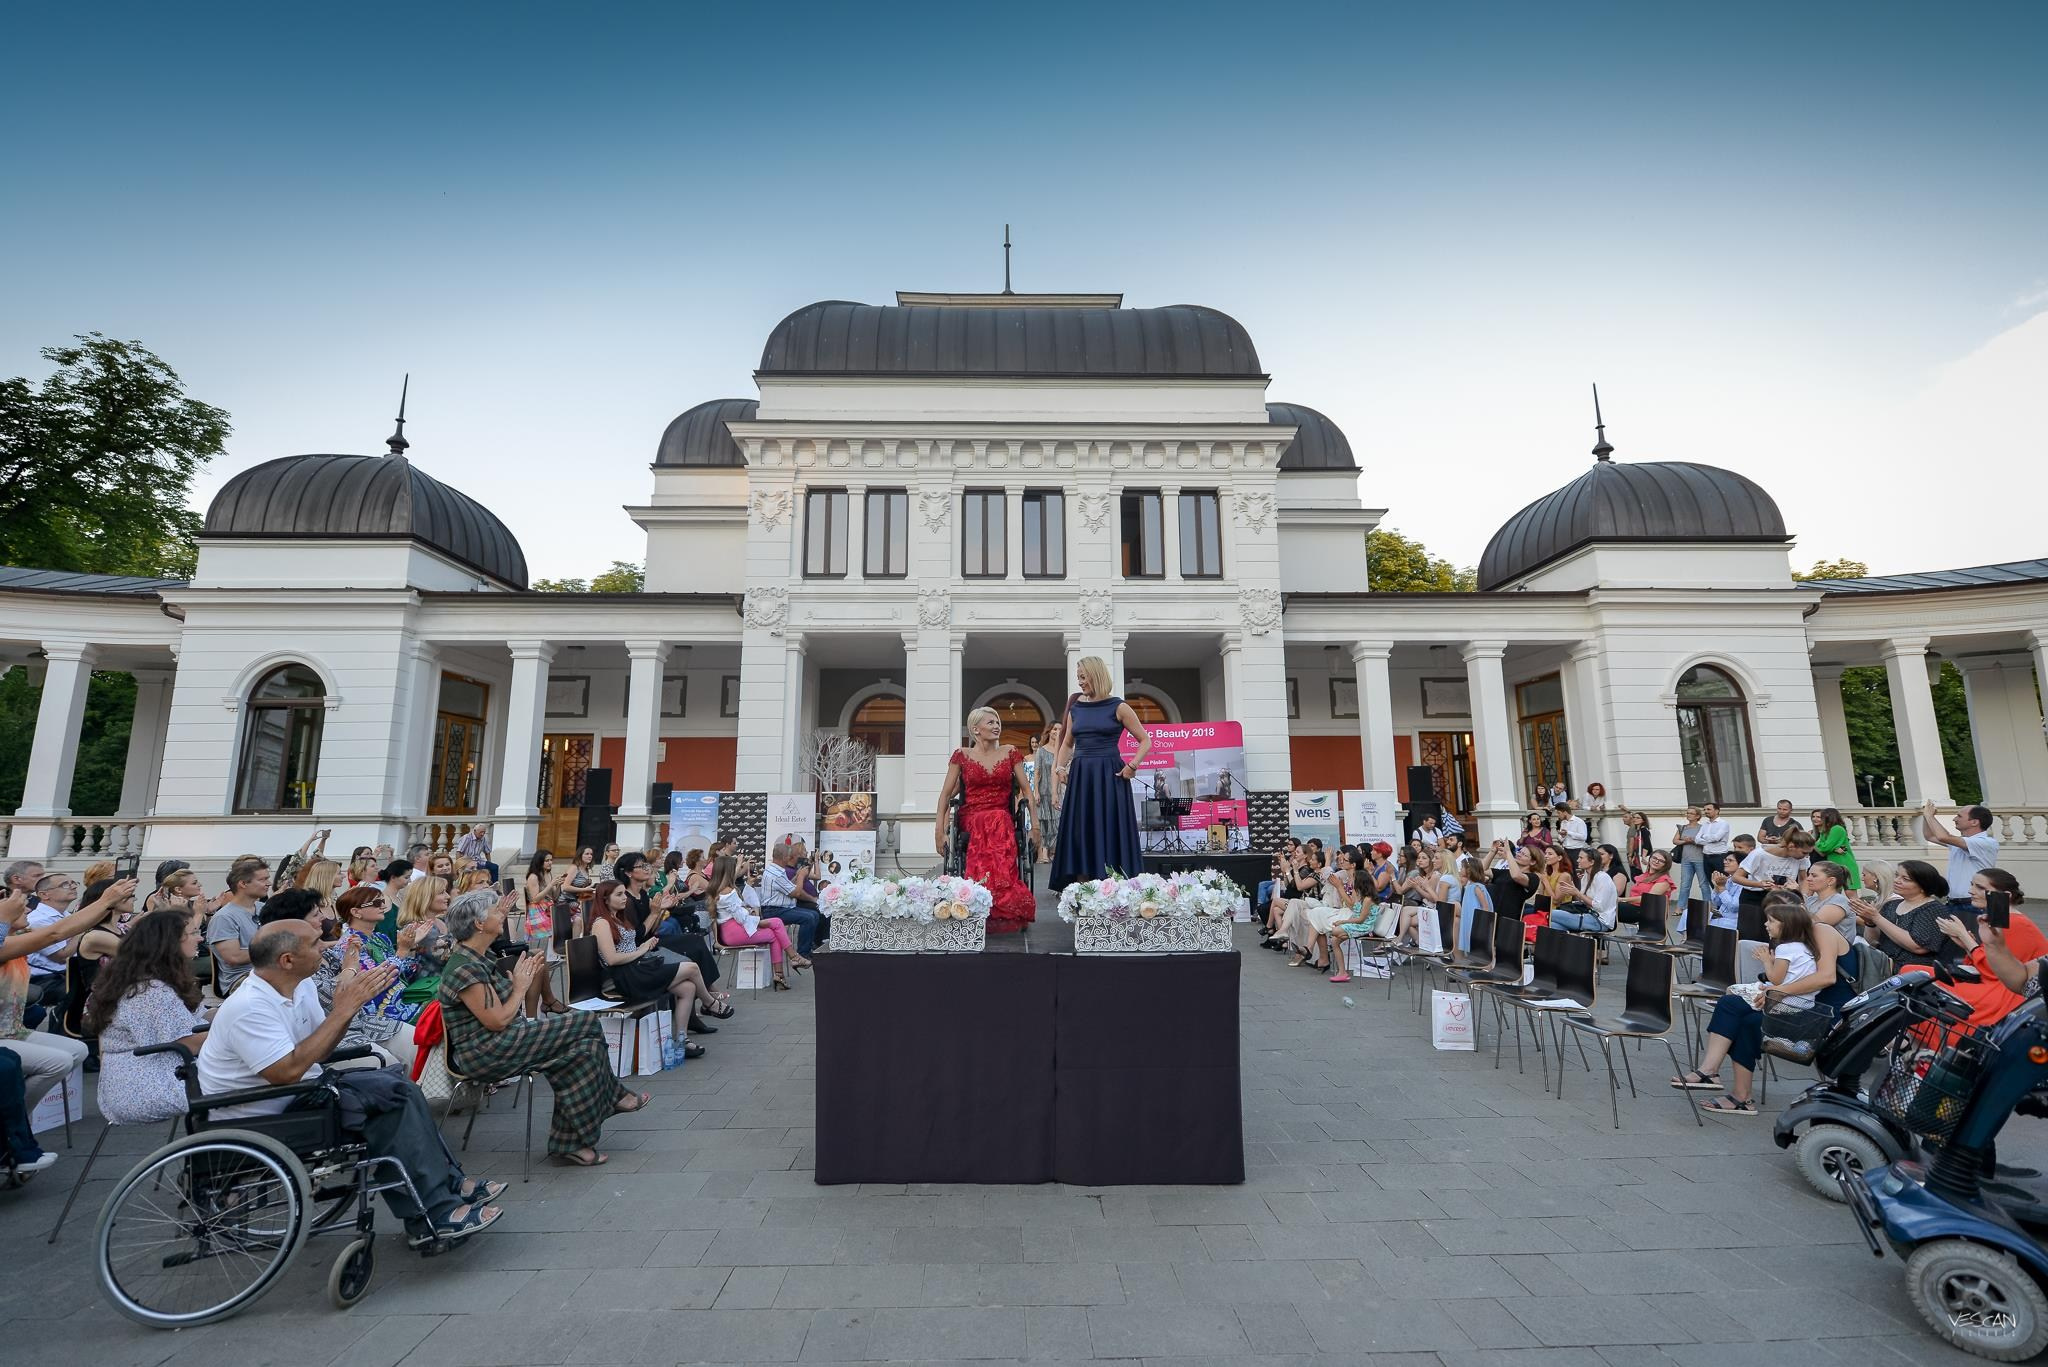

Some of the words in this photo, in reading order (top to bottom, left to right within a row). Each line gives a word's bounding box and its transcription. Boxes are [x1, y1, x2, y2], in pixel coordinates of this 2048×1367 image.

[1156, 728, 1190, 740] Beauty
[1192, 727, 1215, 737] 2018
[1154, 740, 1174, 748] Show
[1295, 808, 1331, 818] wens
